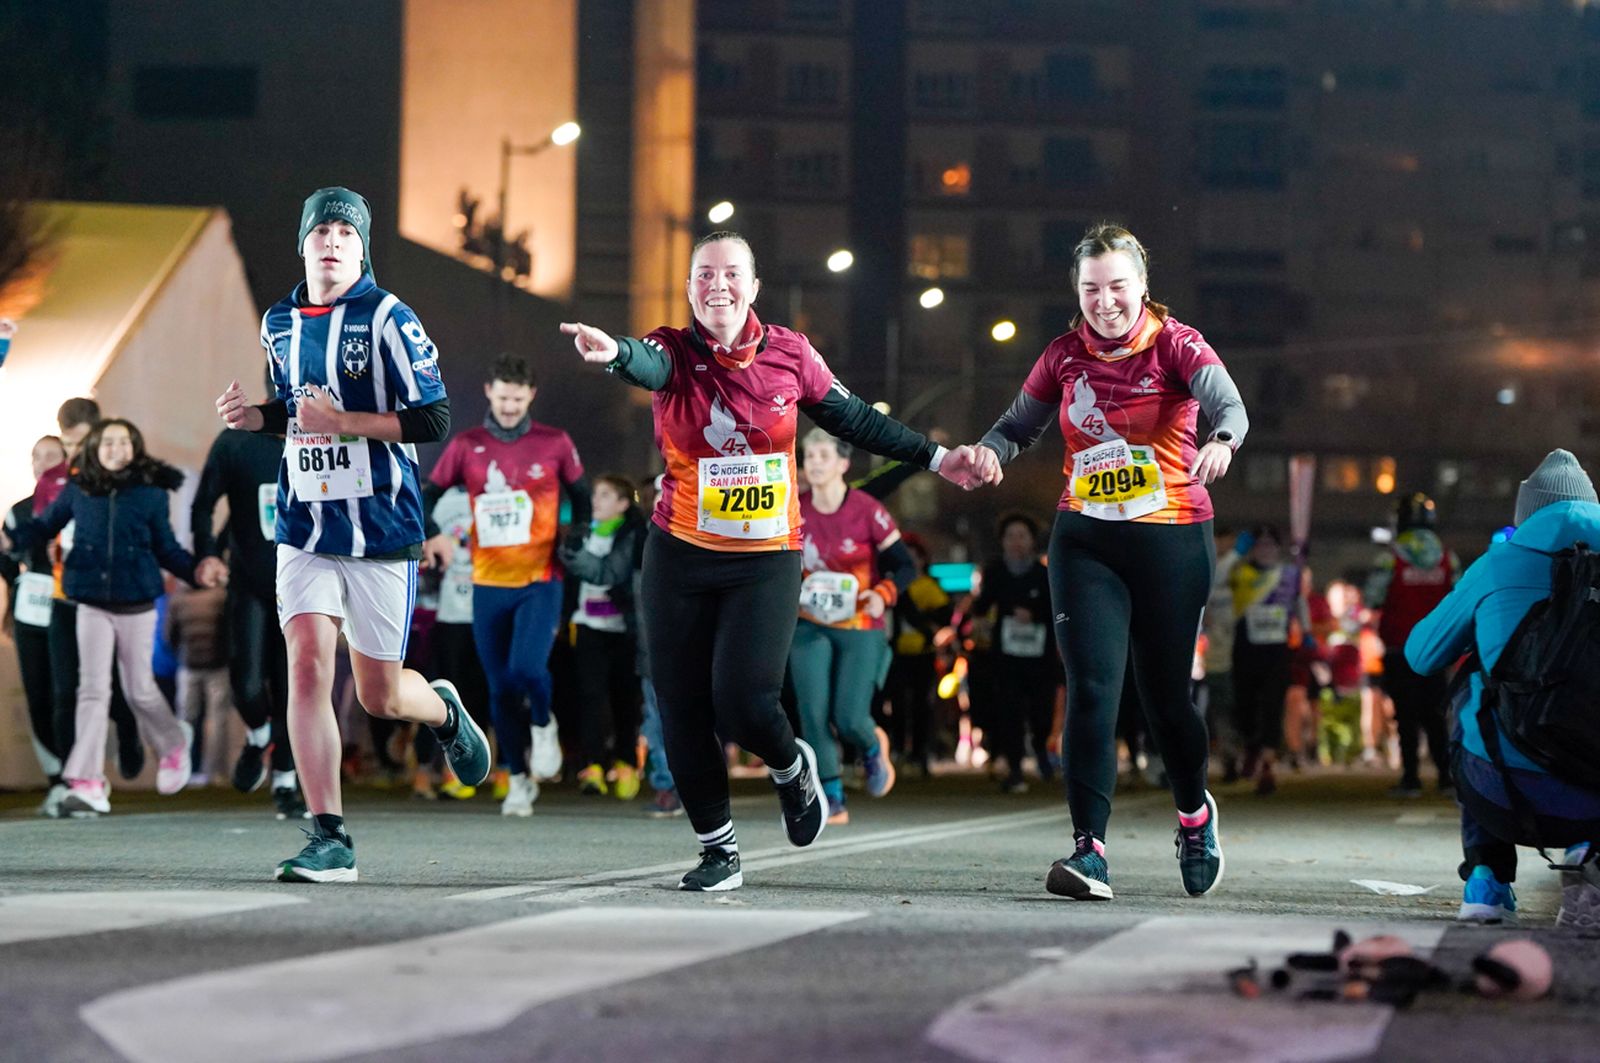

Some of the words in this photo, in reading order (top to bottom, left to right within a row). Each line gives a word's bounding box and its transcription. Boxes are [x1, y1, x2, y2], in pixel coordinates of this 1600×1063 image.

[1081, 415, 1105, 436] 43
[720, 437, 747, 456] 43
[1092, 451, 1115, 462] NOCHE
[1116, 448, 1126, 458] DE
[299, 446, 351, 472] 6814
[721, 465, 748, 476] NOCHE
[750, 465, 759, 474] DE
[1083, 464, 1097, 475] SAN
[710, 478, 728, 487] SAN
[1088, 466, 1147, 497] 2094
[719, 485, 774, 512] 7205
